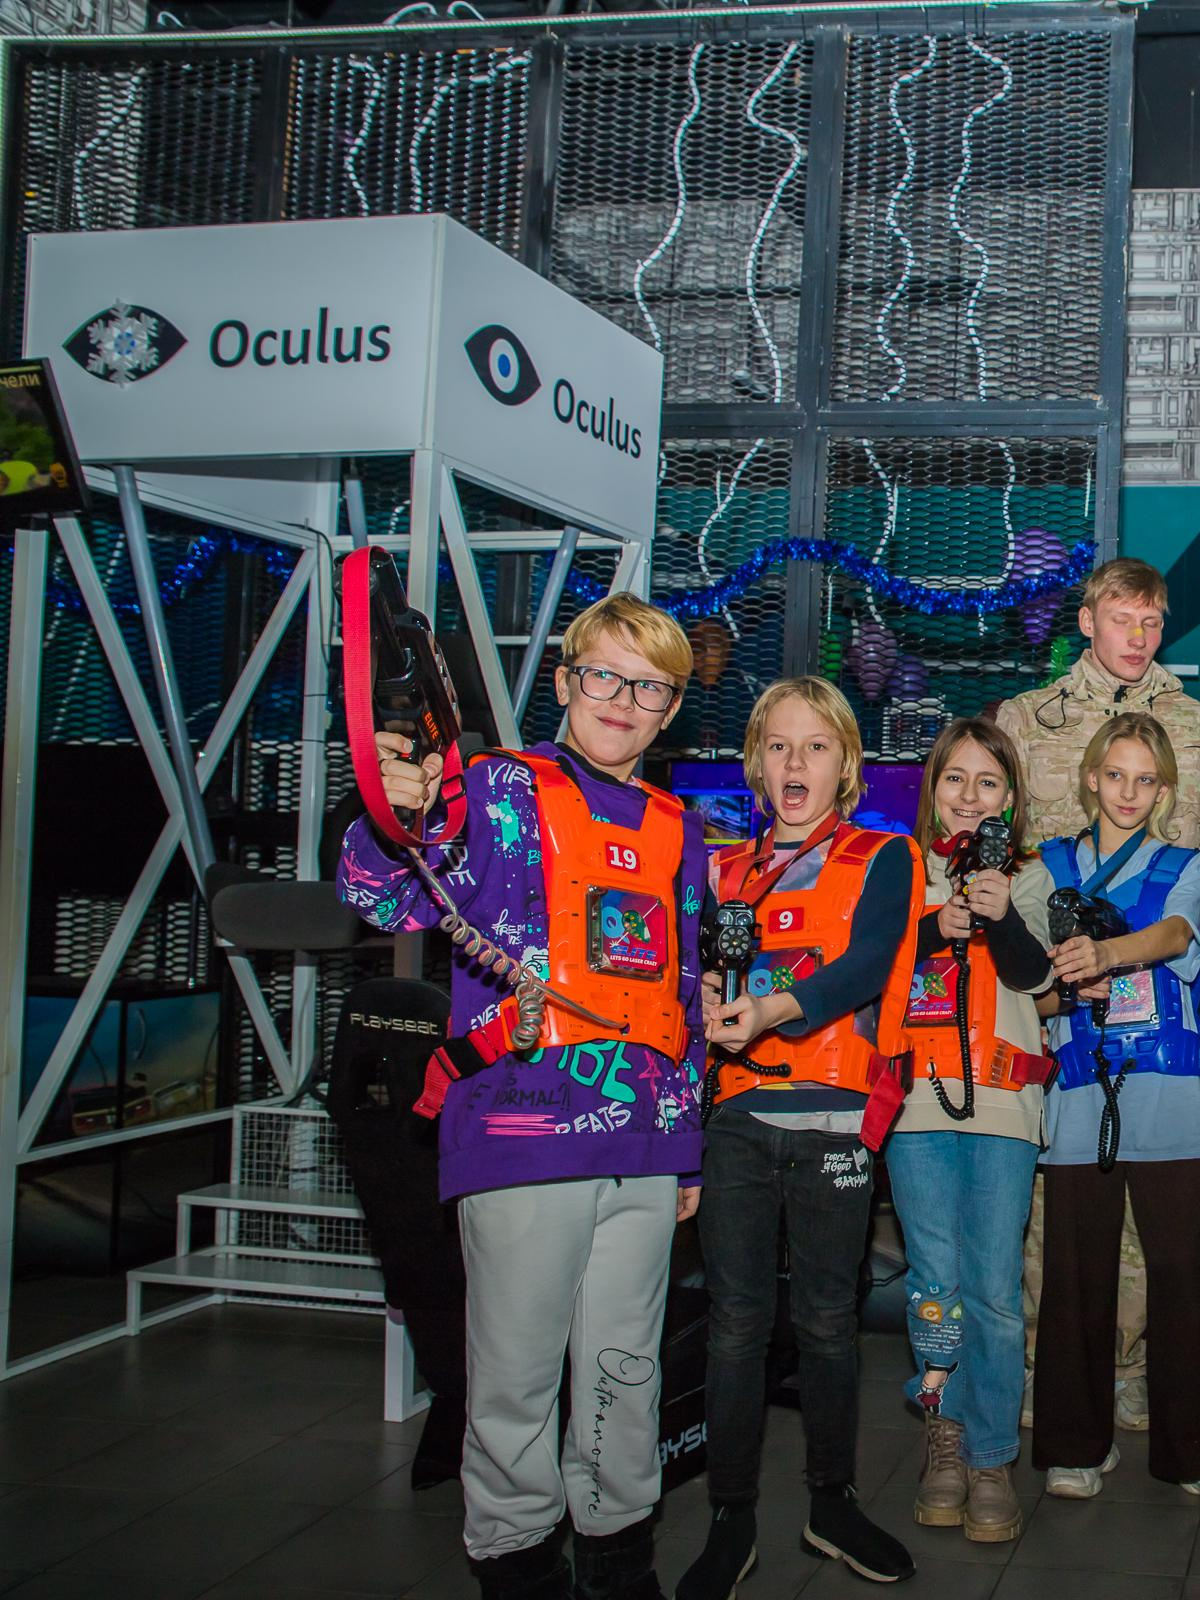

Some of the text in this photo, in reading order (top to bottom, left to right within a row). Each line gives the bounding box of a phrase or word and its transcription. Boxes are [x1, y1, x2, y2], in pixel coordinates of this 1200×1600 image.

[209, 306, 391, 368] Oculus
[553, 378, 642, 459] Oculus
[424, 711, 440, 740] ELITE
[487, 763, 536, 796] VIB
[609, 845, 638, 871] 19
[778, 910, 794, 930] 9
[610, 945, 657, 961] ELITE
[823, 1153, 847, 1162] FORCE
[831, 1162, 852, 1173] GOOD
[832, 1171, 869, 1190] BATMAN
